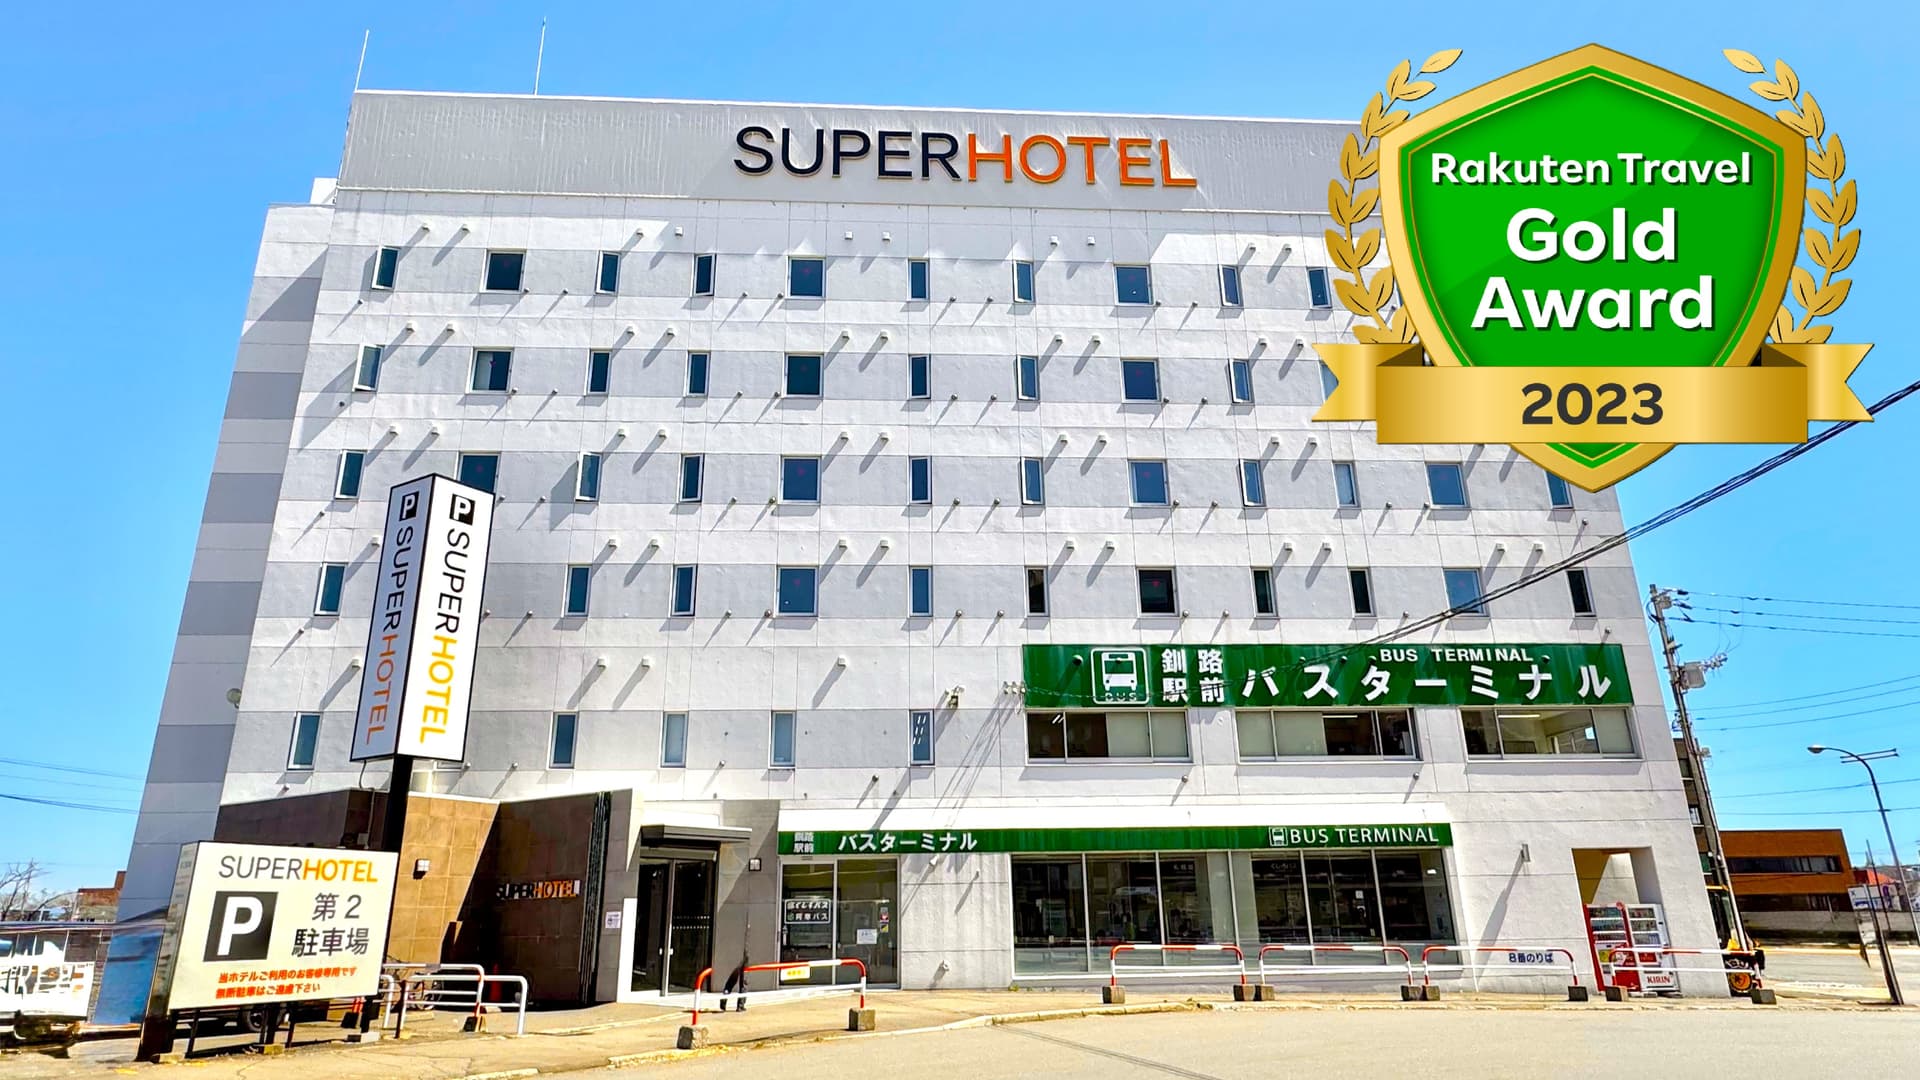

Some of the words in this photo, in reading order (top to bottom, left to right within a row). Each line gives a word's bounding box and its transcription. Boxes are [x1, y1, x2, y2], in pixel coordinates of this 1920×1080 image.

[734, 125, 1198, 188] SUPERHOTEL
[366, 526, 414, 745] SUPERHOTEL
[420, 528, 470, 743] SUPERHOTEL
[1162, 648, 1223, 674] 釧路
[1380, 648, 1418, 662] BUS
[1431, 648, 1533, 662] TERMINAL
[1162, 677, 1225, 702] 駅前
[1242, 664, 1612, 701] バスターミナル
[838, 832, 977, 852] バスターミナル
[1290, 828, 1329, 844] BUS
[1335, 826, 1439, 844] TERMINAL
[218, 855, 378, 883] SUPERHOTEL
[217, 896, 264, 956] P
[292, 928, 369, 957] 駐車場
[1646, 975, 1671, 984] KIRIN
